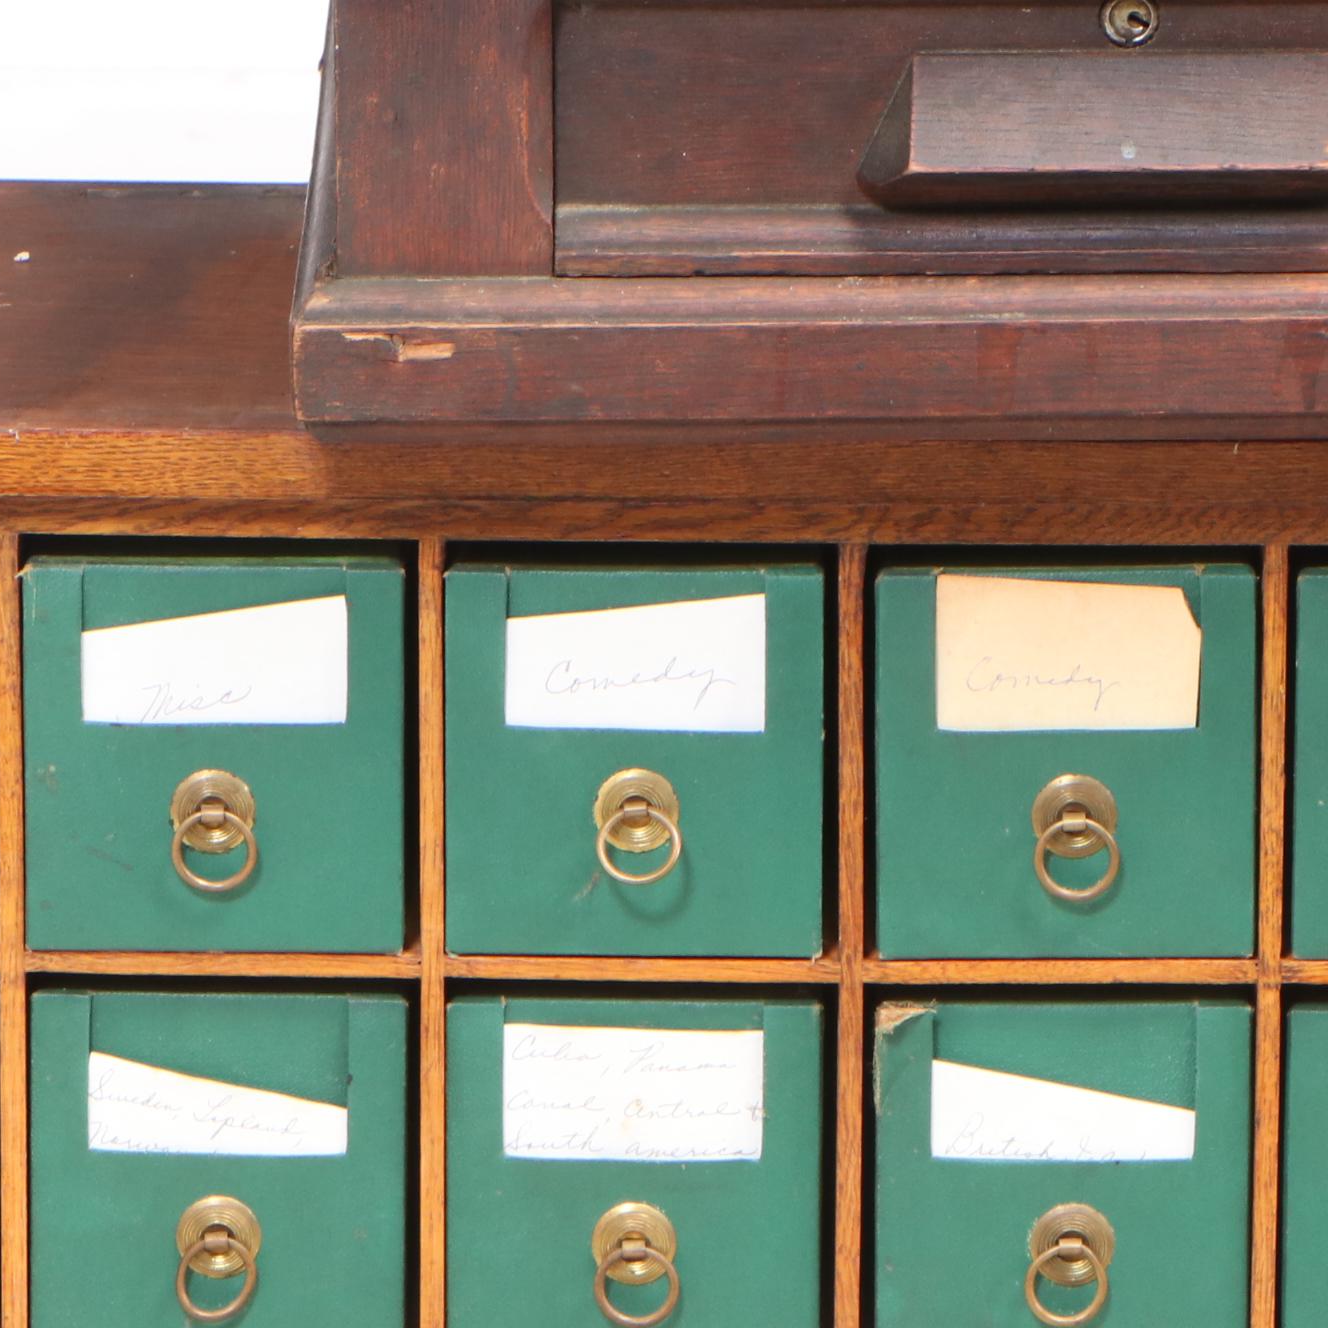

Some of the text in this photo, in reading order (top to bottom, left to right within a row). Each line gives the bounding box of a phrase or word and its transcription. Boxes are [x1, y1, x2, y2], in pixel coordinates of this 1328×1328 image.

[545, 656, 736, 711] Comedy
[965, 656, 1121, 712] Comedy
[505, 1121, 604, 1154] South
[944, 1111, 1054, 1160] British
